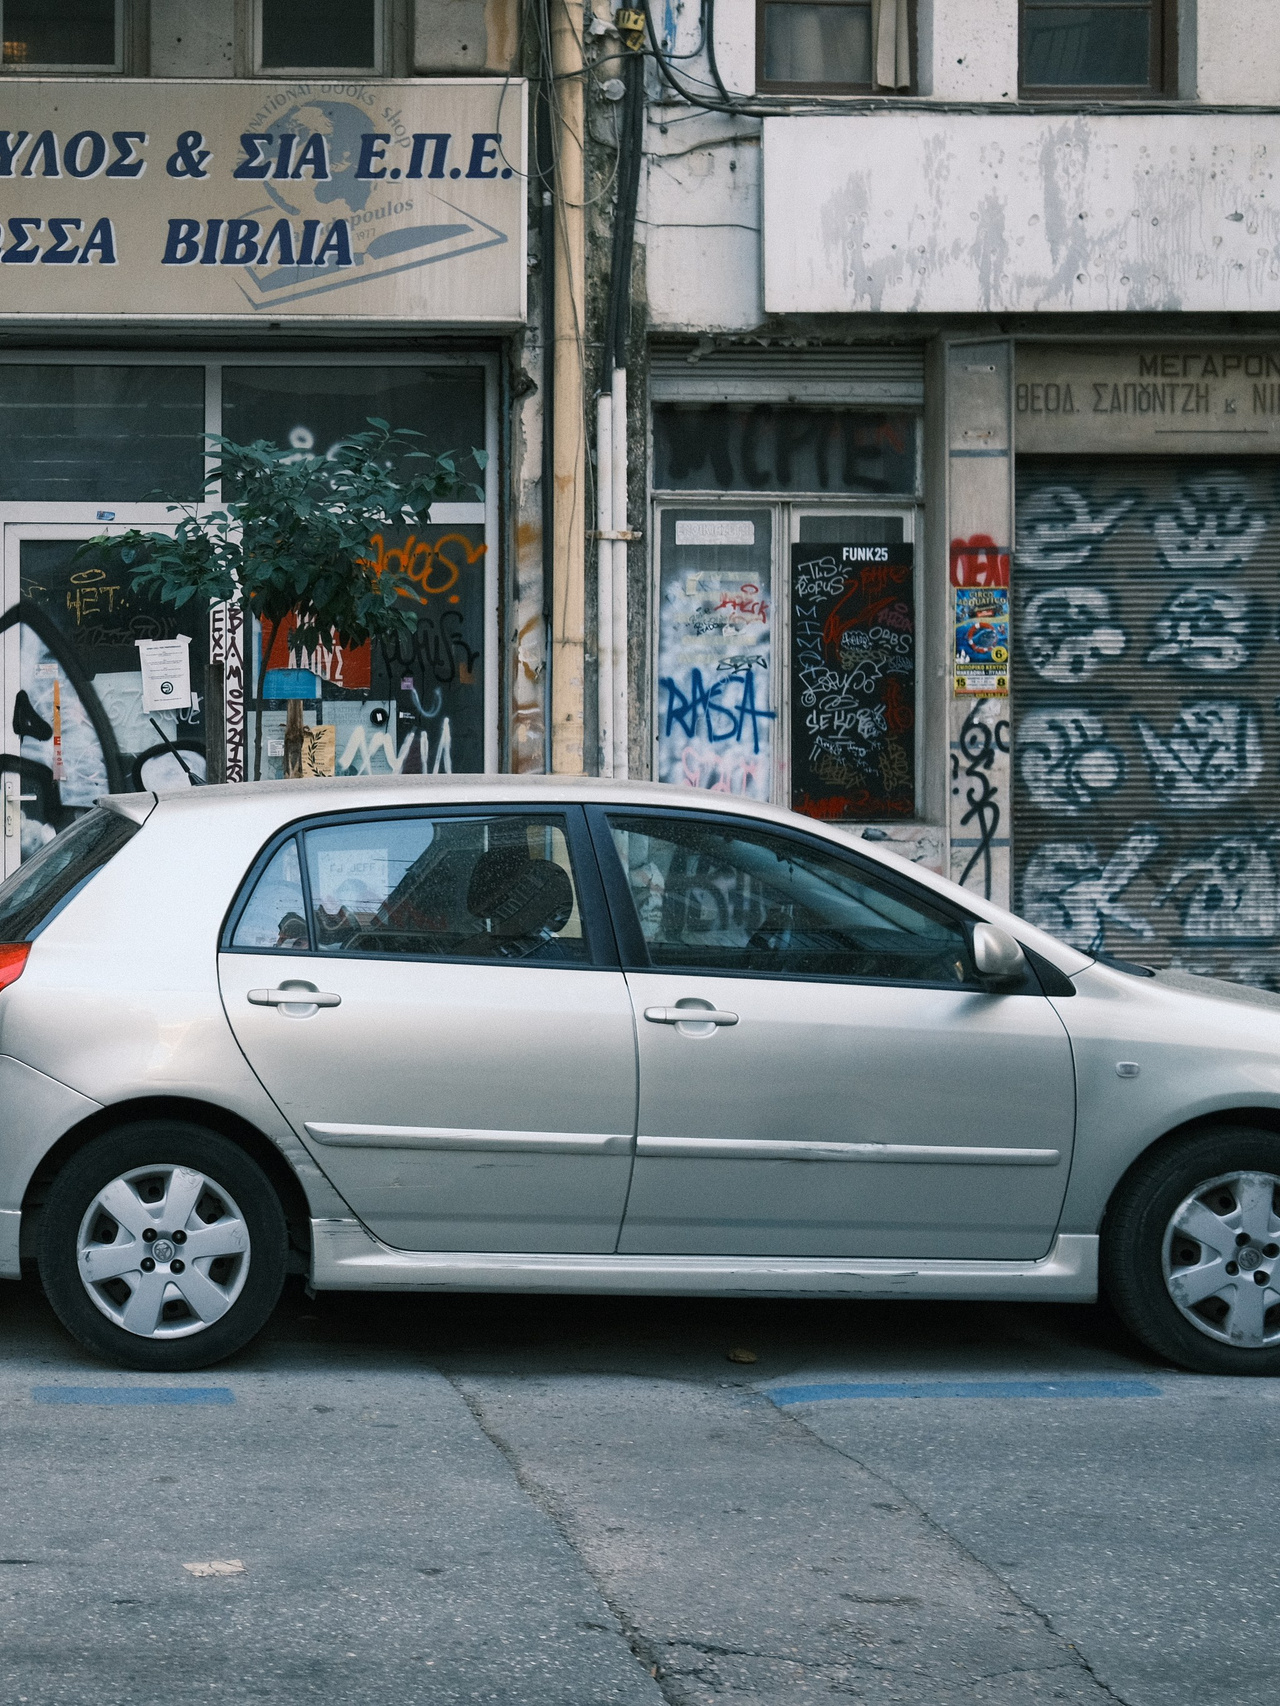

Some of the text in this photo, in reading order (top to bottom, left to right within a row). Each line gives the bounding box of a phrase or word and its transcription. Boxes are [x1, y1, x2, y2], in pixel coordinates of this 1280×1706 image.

[165, 130, 213, 179] &
[233, 133, 333, 181] ΣΙΑ
[354, 133, 515, 181] Ε.Π.Ε.
[160, 218, 357, 268] ΒΙΒΛΙΑ
[842, 547, 889, 561] FUNK25
